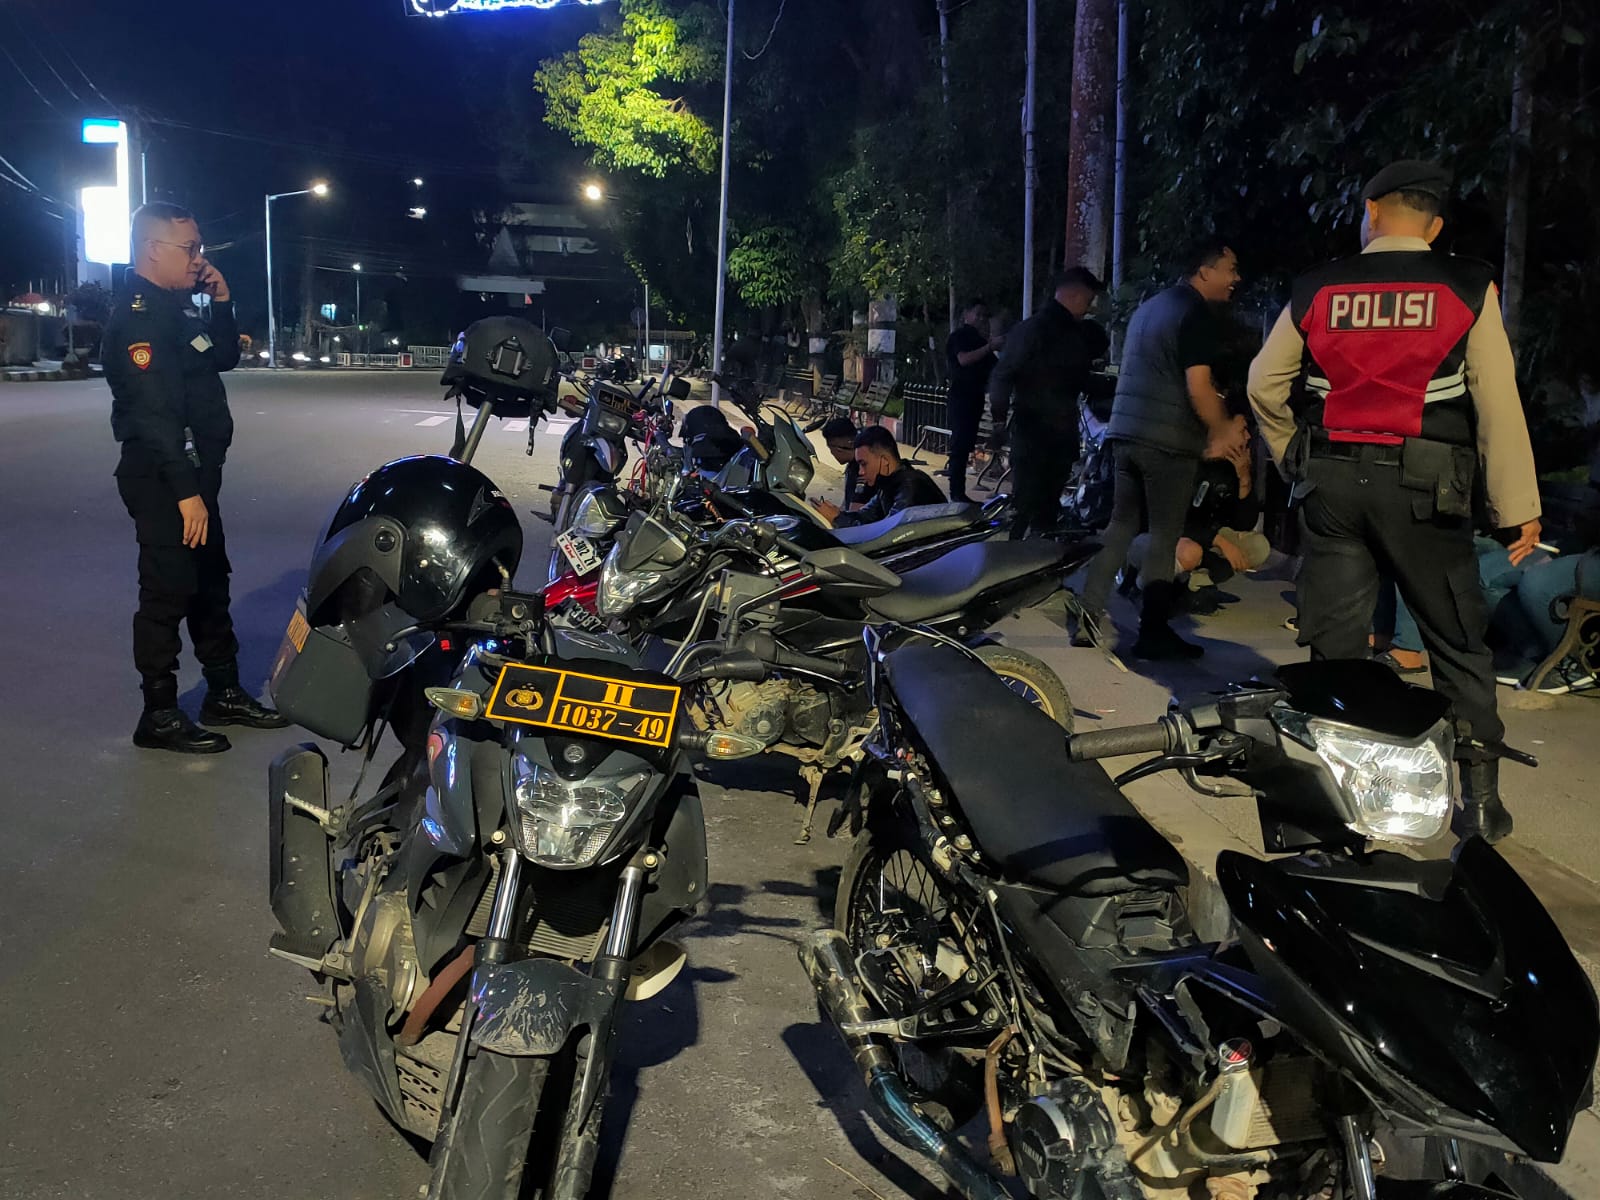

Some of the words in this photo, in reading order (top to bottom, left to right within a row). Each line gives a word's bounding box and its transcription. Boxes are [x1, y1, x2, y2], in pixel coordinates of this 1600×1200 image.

[1331, 292, 1435, 328] POLISI
[601, 682, 637, 708] II
[557, 703, 665, 740] 1037-49
